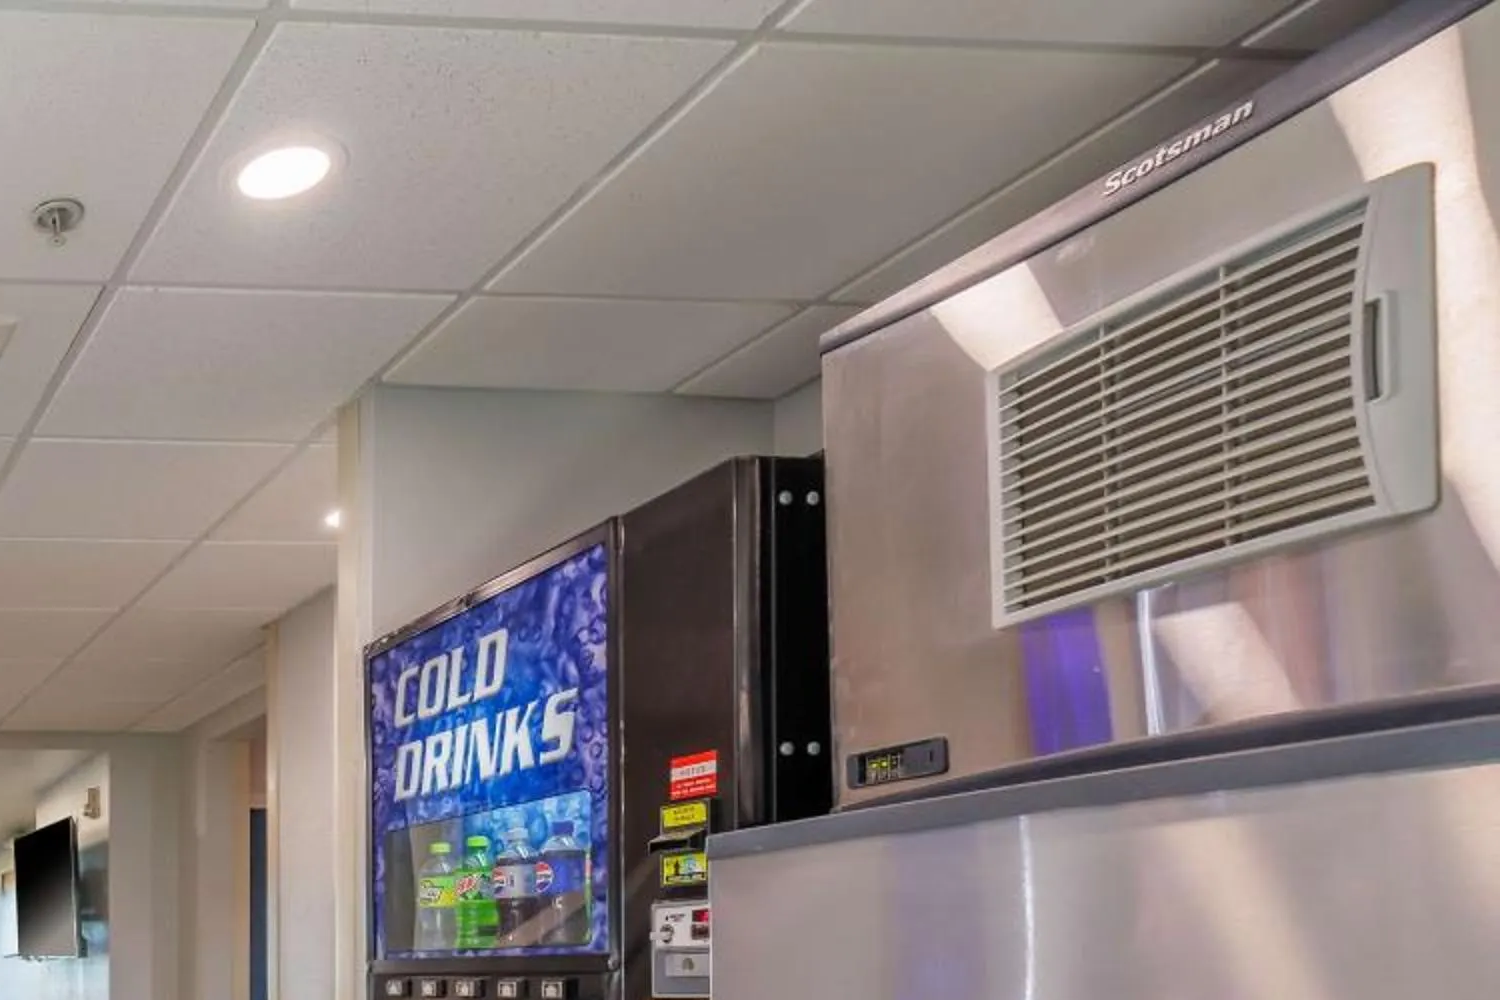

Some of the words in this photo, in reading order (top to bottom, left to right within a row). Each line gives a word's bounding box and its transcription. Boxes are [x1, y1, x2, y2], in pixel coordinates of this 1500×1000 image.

[1102, 100, 1254, 196] Scotsman
[394, 628, 509, 729] COLD
[393, 687, 578, 803] DRINKS
